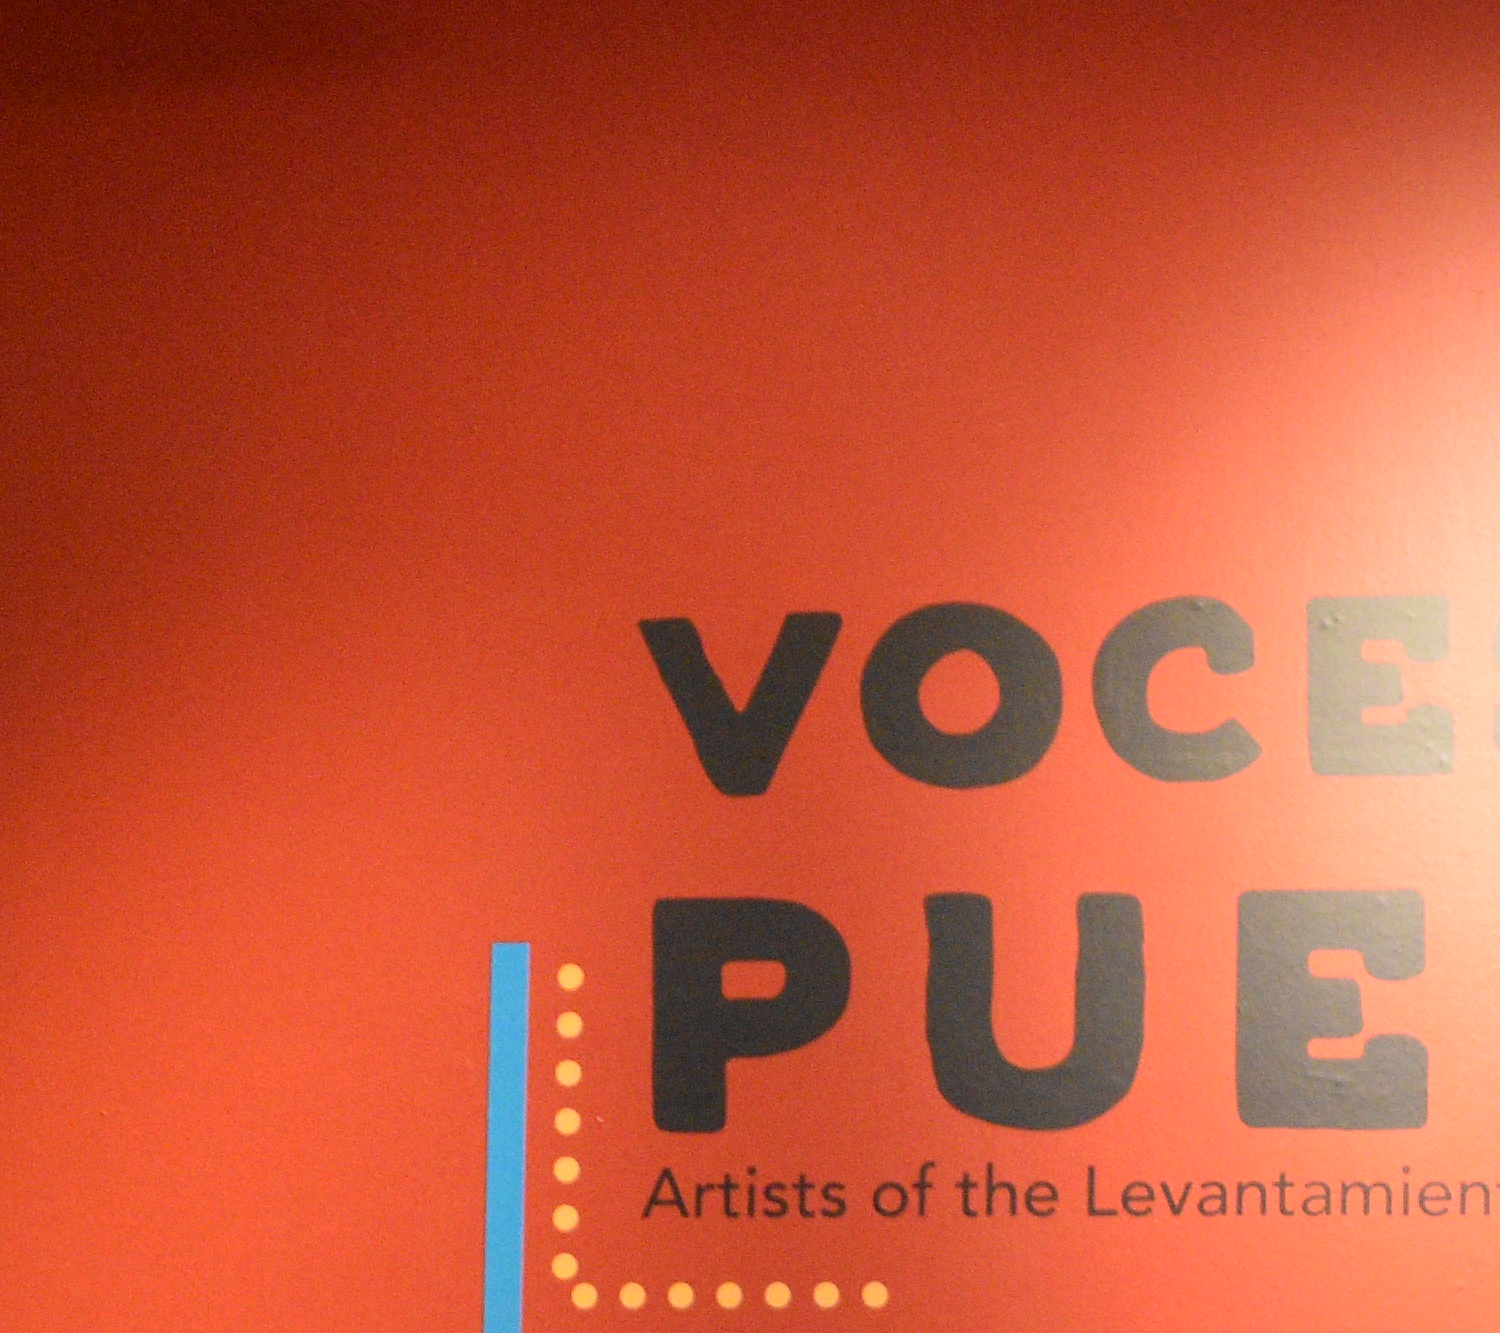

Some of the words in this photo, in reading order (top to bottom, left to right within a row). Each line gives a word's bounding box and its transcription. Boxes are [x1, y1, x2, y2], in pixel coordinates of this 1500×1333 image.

[642, 1166, 847, 1218] Artists
[871, 1162, 937, 1218] of
[954, 1162, 1059, 1217] the
